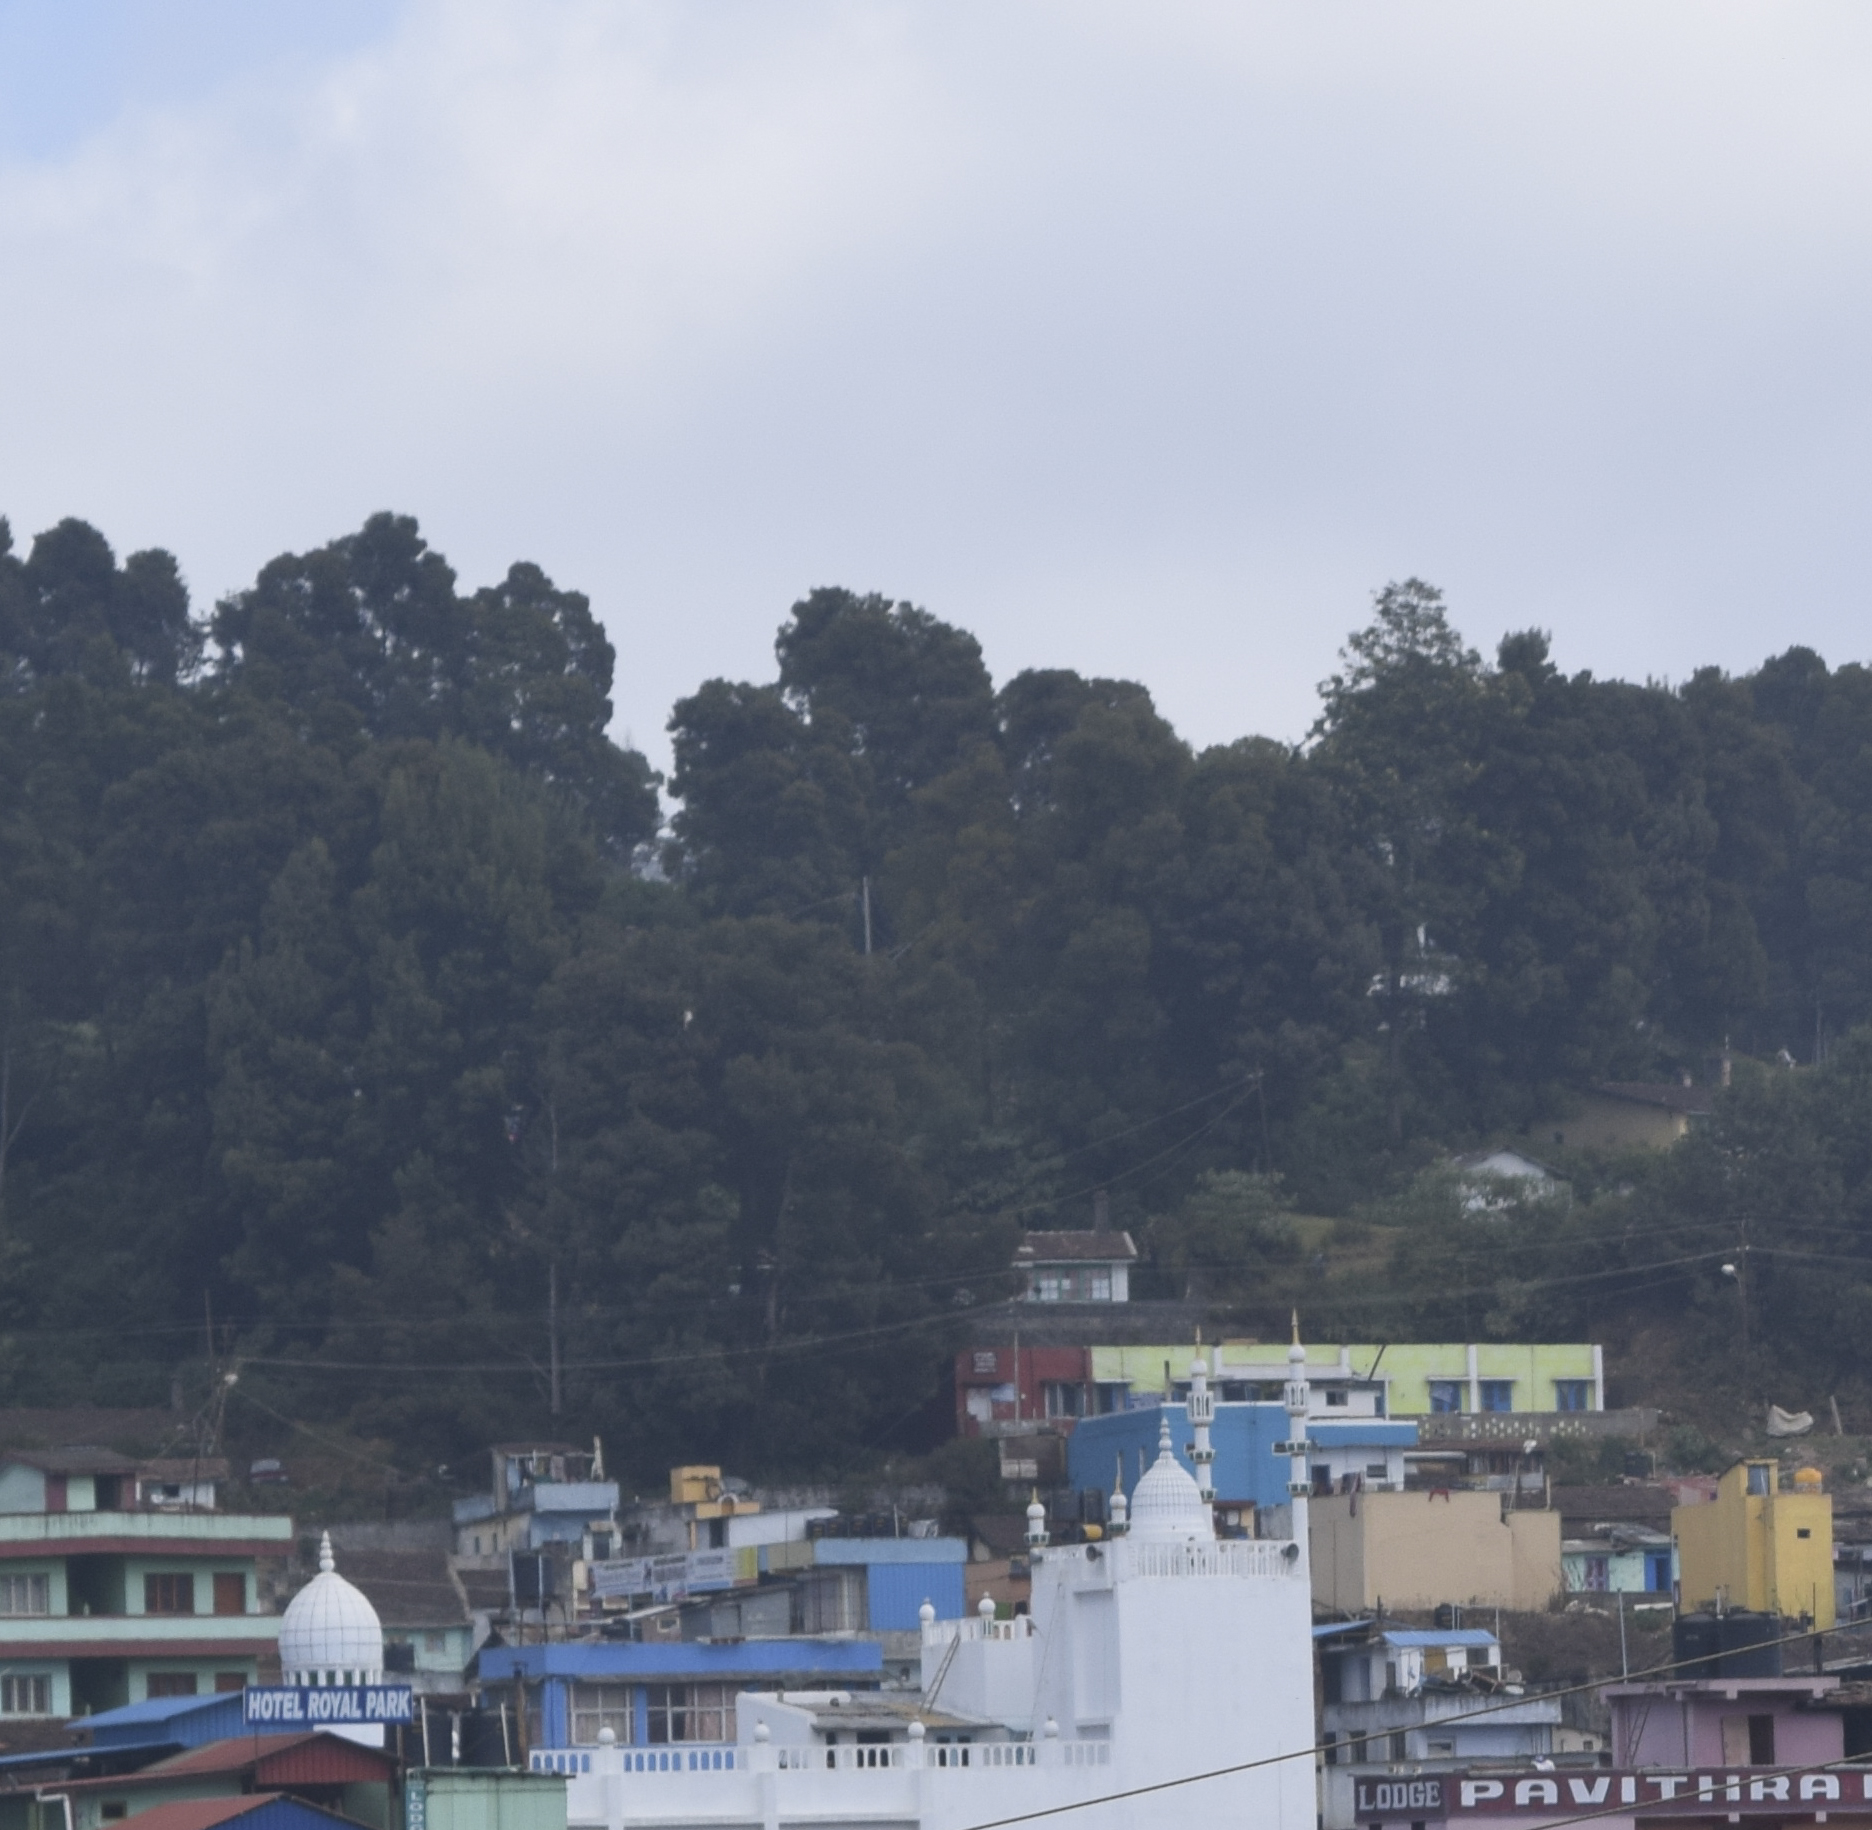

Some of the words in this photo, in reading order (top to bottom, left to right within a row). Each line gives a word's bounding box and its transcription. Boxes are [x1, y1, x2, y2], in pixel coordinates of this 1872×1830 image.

[248, 1691, 303, 1720] HOTEL
[307, 1691, 362, 1719] ROYAL
[365, 1690, 411, 1718] PARK
[1358, 1780, 1441, 1811] LODGE
[1460, 1774, 1841, 1807] PAVITHRA
